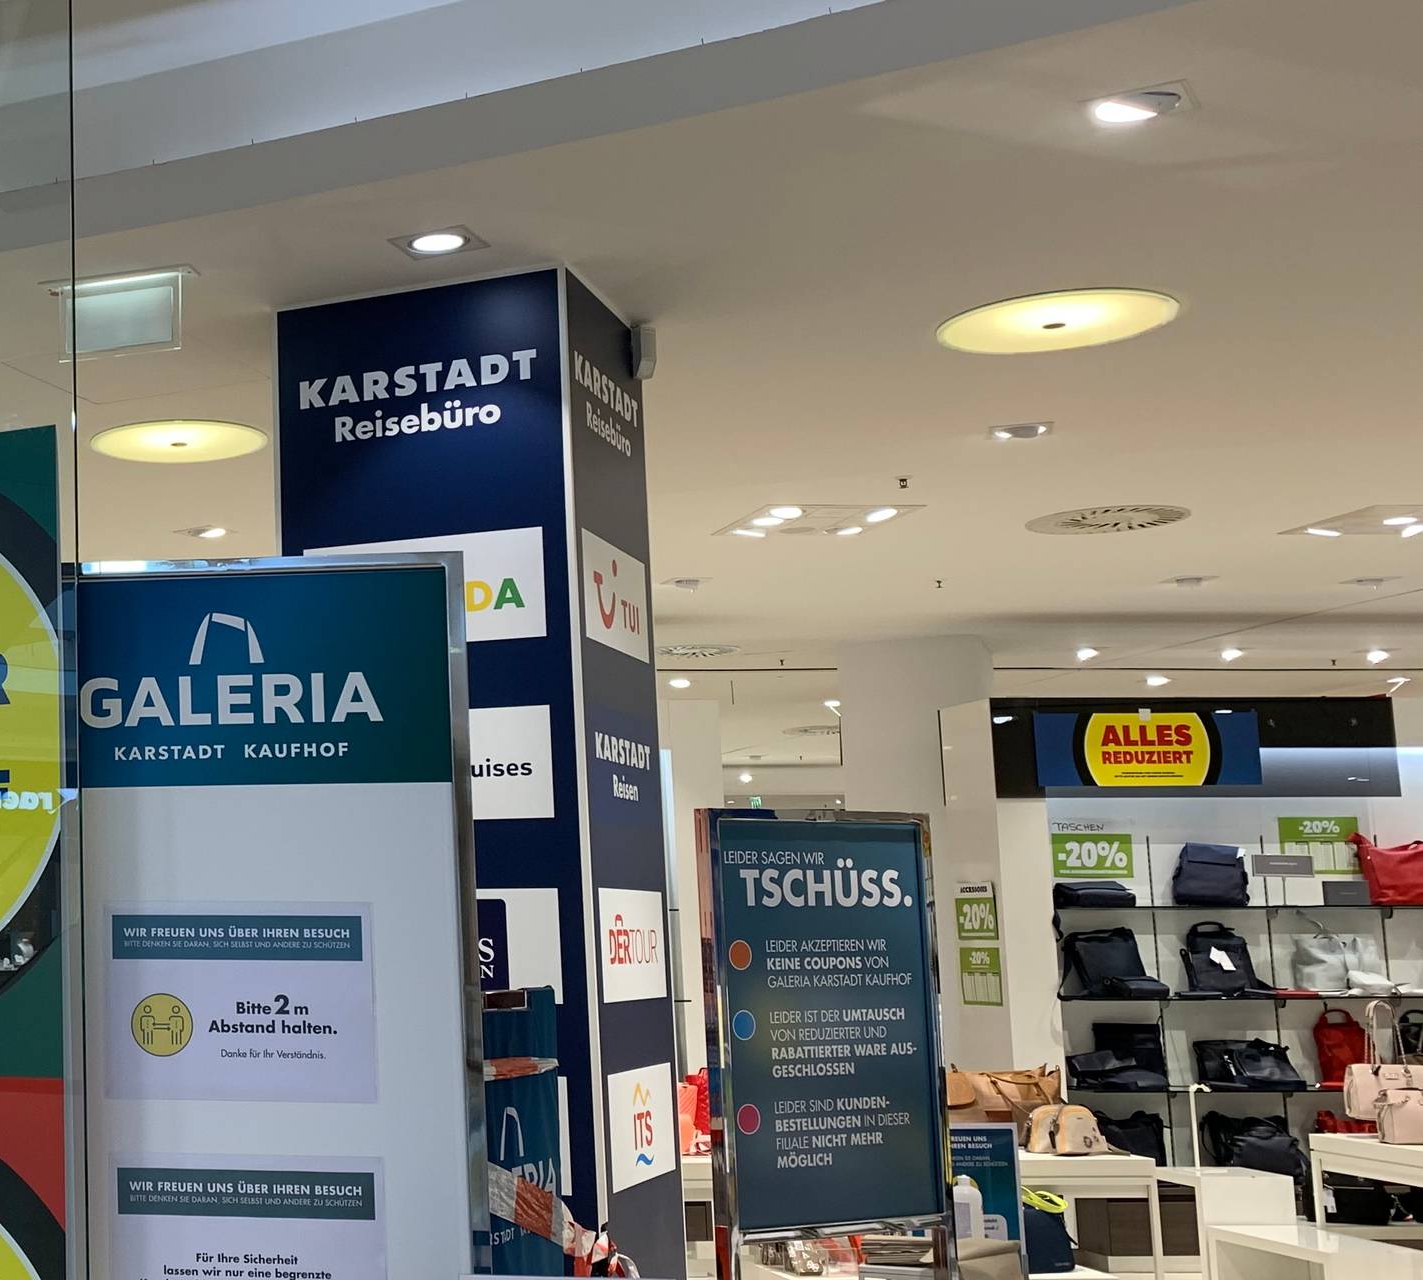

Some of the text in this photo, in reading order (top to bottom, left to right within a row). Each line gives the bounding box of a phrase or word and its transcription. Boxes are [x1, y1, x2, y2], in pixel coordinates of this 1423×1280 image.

[299, 348, 537, 410] KARSTADT
[574, 350, 638, 428] KARSTADT
[335, 399, 502, 443] Reisebüro
[586, 401, 632, 457] Reisebüro
[464, 577, 526, 612] DA
[621, 598, 640, 635] TUI
[79, 671, 384, 729] GALERIA
[1101, 724, 1192, 746] ALLES
[114, 741, 349, 761] KARSTADT KAUFHOF
[595, 731, 651, 771] KARSTADT
[1101, 750, 1193, 765] REDUZIERT
[470, 758, 533, 778] uises
[613, 774, 639, 802] Reisen
[1052, 822, 1105, 832] TASCHEN
[1298, 820, 1340, 833] -20%
[724, 851, 825, 865] LEIDER SAGEN WIR
[1058, 841, 1128, 868] -20%
[739, 858, 913, 908] TSCHÜSS.
[959, 903, 995, 930] -20%
[123, 925, 350, 938] WIR FREUEN UNS ÜBER IHREN BESUCH
[142, 940, 171, 948] DENKEN
[213, 940, 229, 949] SICH
[254, 941, 271, 949] UND
[273, 941, 302, 949] ANDERE
[302, 941, 312, 949] ZU
[609, 928, 659, 966] DERTOUR
[765, 938, 887, 953] LEIDER AKZEPTIEREN WIR
[767, 956, 889, 970] KEINE COUPONS VON
[969, 951, 990, 965] -20%
[767, 972, 912, 989] GALERIA KARSTADT KAUFHOF
[236, 994, 309, 1015] Bitte 2 m
[769, 1007, 905, 1024] LEIDER IST DER UMTAUSCH
[208, 1019, 338, 1035] Abstand halten.
[770, 1026, 887, 1042] VON REDUZIERTER UND
[220, 1049, 326, 1060] Danke für Ihr Verständnis.
[771, 1042, 917, 1061] RABATTIERTER WARE AUS-
[772, 1062, 855, 1079] GESCHLOSSEN
[774, 1096, 890, 1114] LEIDER SIND KUNDEN-
[633, 1110, 653, 1151] ITS
[775, 1112, 911, 1133] BESTELLUNGEN IN DIESER
[776, 1131, 884, 1151] FILIALE NICHT MEHR
[777, 1152, 833, 1169] MÖGLICH
[129, 1180, 362, 1196] WIR FREUEN UNS ÜBER IHREN BESUCH
[148, 1194, 178, 1202] DENKEN
[222, 1196, 239, 1204] SICH
[264, 1197, 282, 1205] UND
[283, 1198, 312, 1206] ANDERE
[313, 1198, 323, 1206] ZU
[196, 1253, 298, 1265] Für Ihre Sicherheit
[163, 1265, 332, 1280] lassen wir nur eine begrenzte
